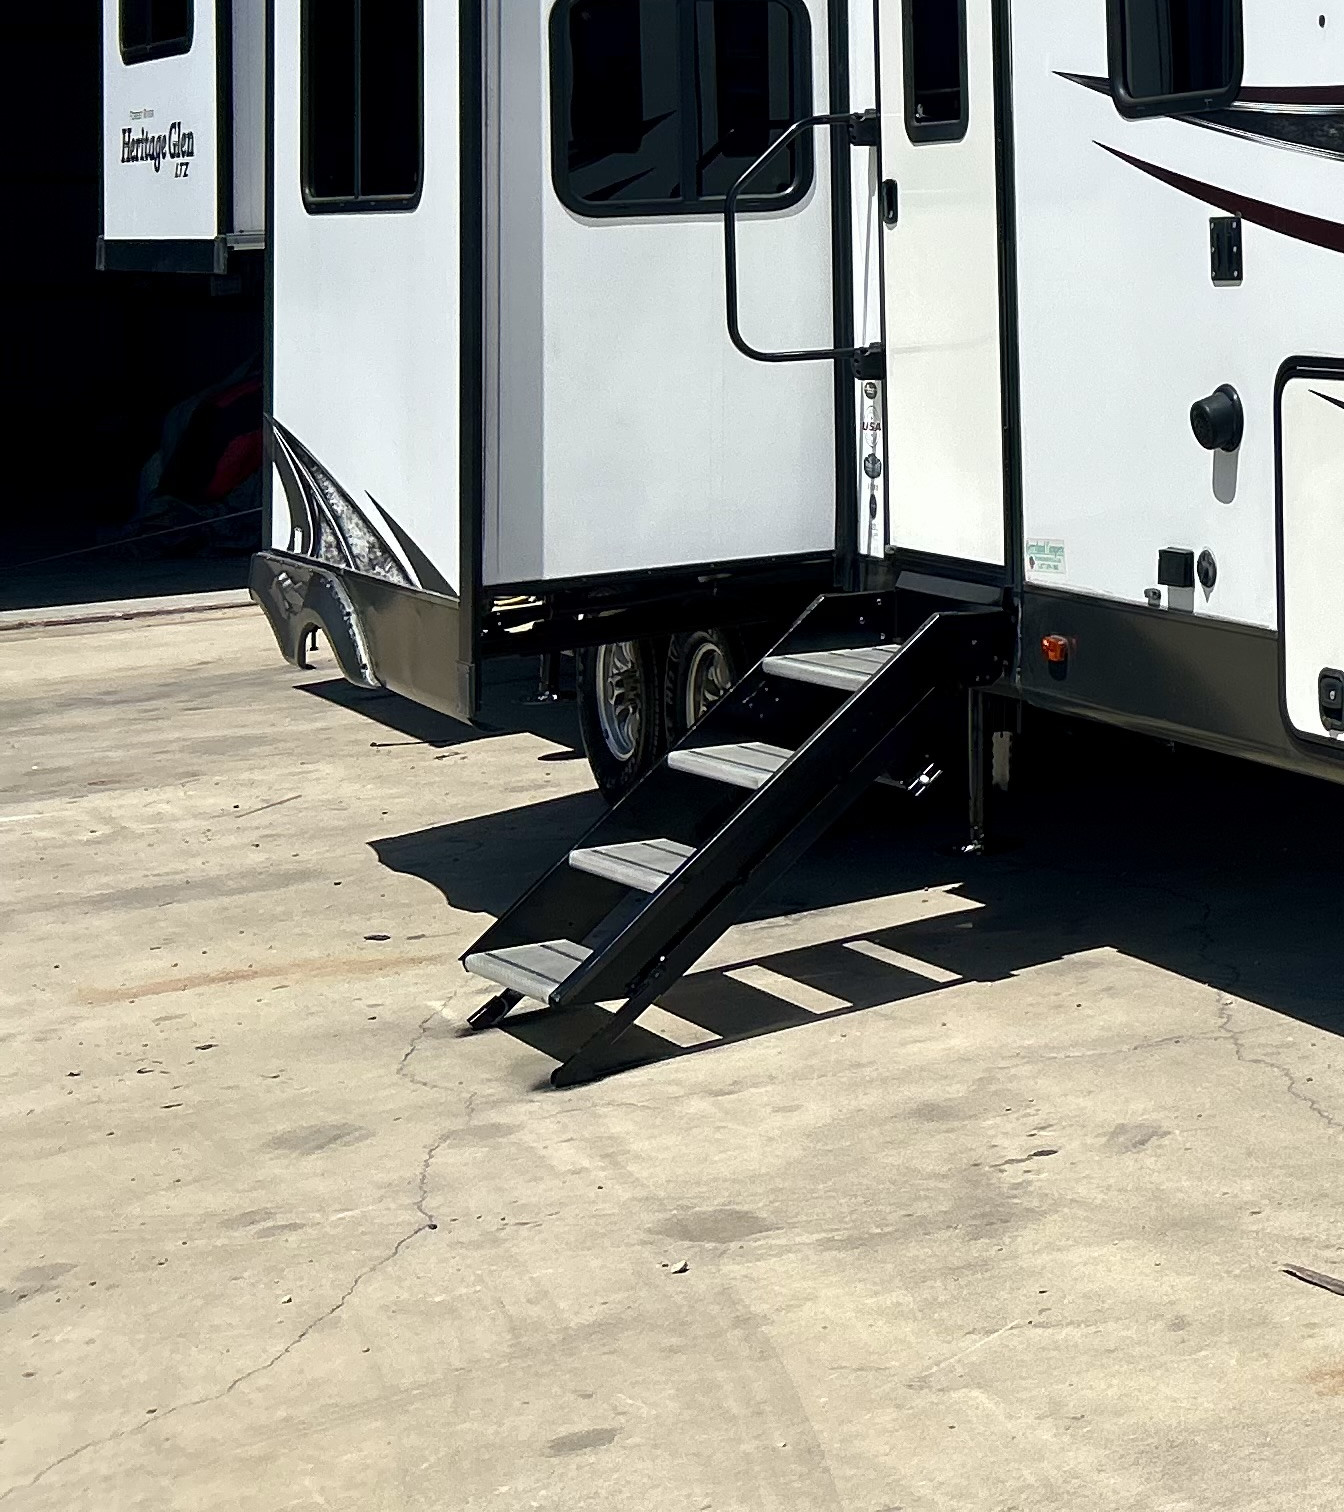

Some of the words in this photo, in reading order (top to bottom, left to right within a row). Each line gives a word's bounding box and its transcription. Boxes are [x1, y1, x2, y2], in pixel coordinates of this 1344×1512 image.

[121, 126, 167, 173] Heritage
[168, 121, 195, 159] Glen
[174, 161, 190, 178] LTZ
[862, 421, 882, 432] USA
